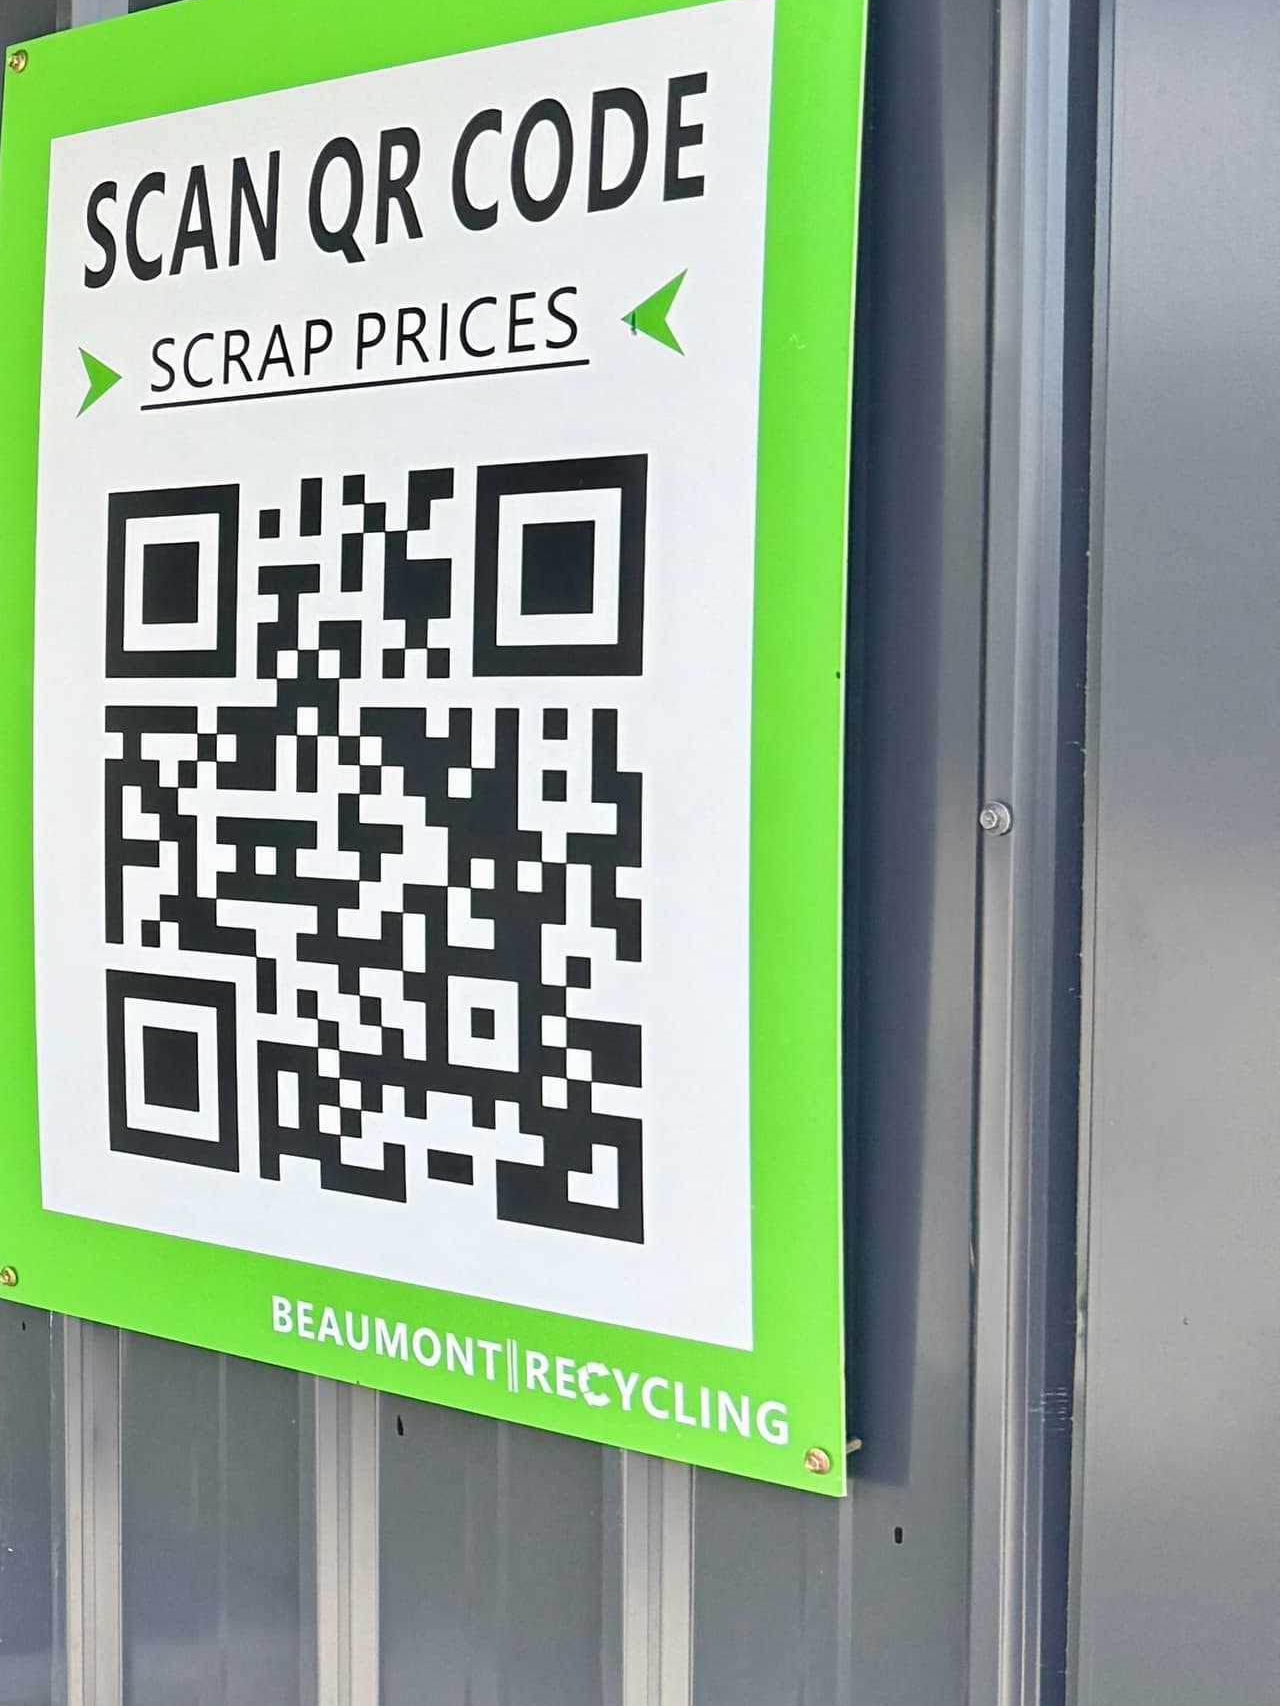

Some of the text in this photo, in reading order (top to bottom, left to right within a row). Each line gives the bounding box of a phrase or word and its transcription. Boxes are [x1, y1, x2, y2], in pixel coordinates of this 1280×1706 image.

[83, 73, 709, 288] SCAN QR CODE
[151, 287, 579, 392] SCRAP PRICES
[271, 1296, 789, 1444] BEAUMONT RECYCLING
